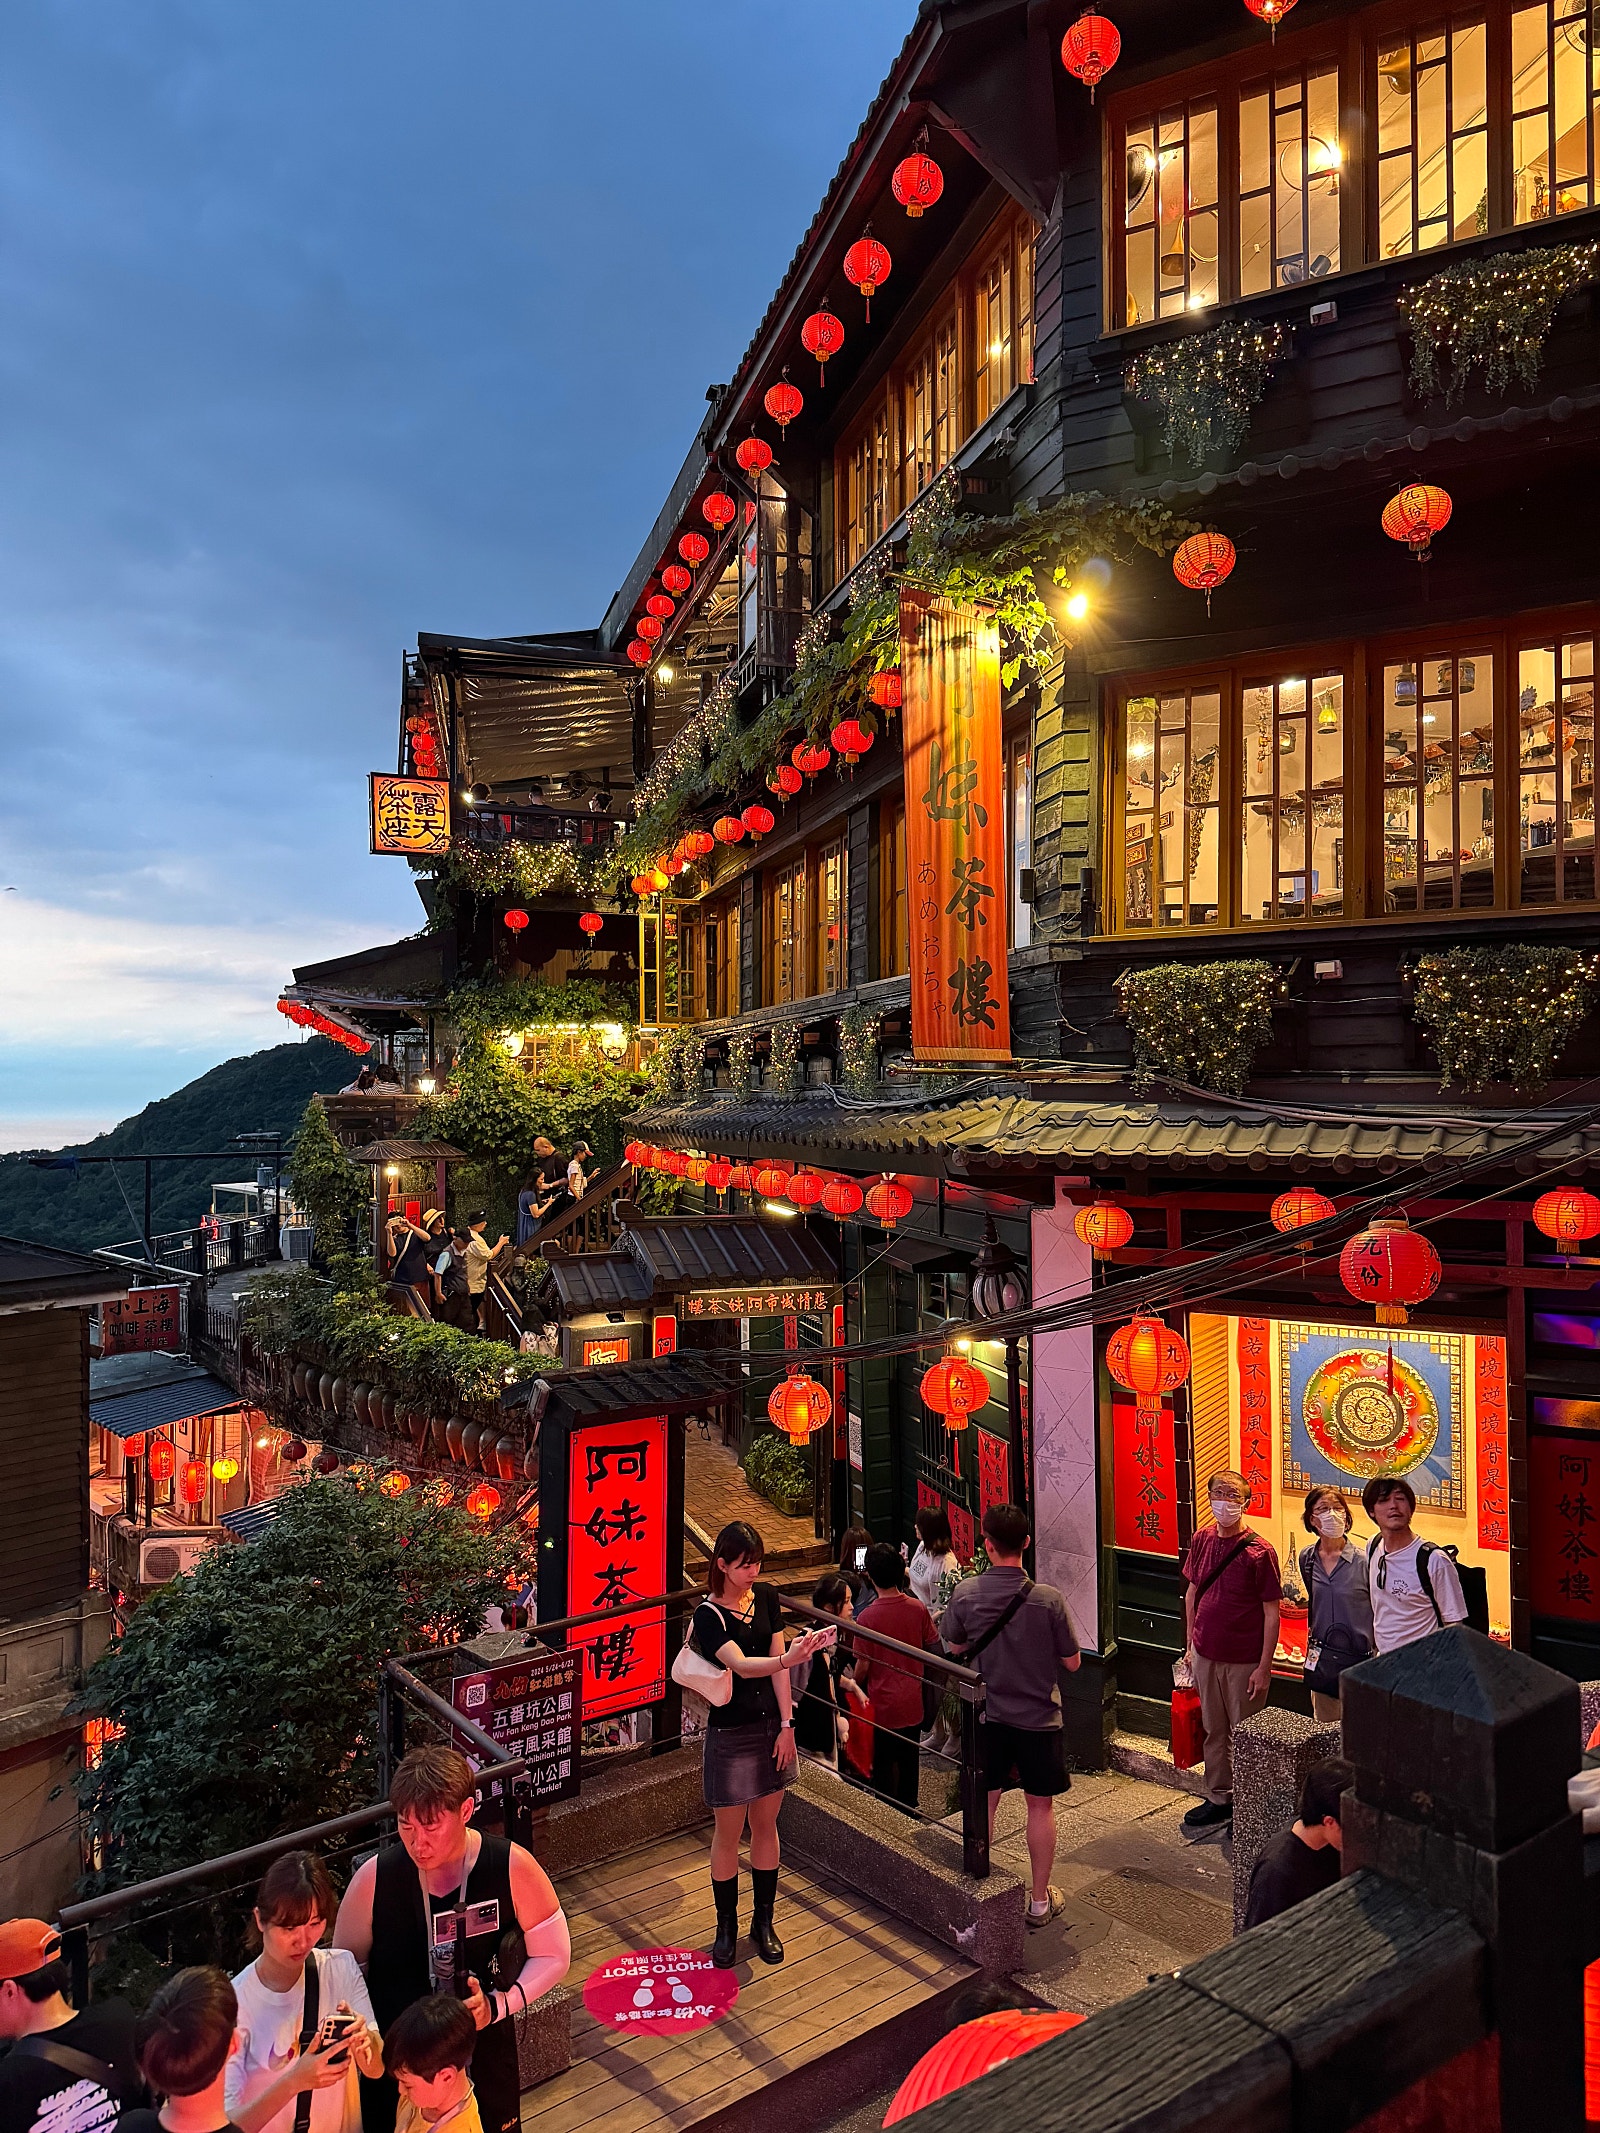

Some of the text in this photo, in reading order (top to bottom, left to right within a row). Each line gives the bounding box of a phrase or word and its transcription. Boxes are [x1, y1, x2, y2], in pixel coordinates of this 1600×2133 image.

[918, 160, 936, 195] 九份
[870, 241, 884, 273] 九份
[821, 314, 835, 343] 九份
[1404, 490, 1422, 519] 九份
[918, 860, 947, 1020] あめおちゃ
[842, 1187, 853, 1212] 九份
[887, 1189, 900, 1218] 九份
[1088, 1213, 1100, 1244] 九份
[1564, 1198, 1580, 1236] 九份
[1360, 1238, 1384, 1288] 九份
[109, 1293, 173, 1315] 小上海
[1111, 1340, 1127, 1384] 九份
[1164, 1344, 1182, 1387] 九份
[952, 1376, 969, 1407] 九份
[1132, 1408, 1167, 1542] 阿妹茶樓
[1555, 1454, 1598, 1604] 阿妹茶樓
[585, 1440, 650, 1681] 阿妹茶樓
[531, 1666, 544, 1677] 2024
[492, 1692, 572, 1730] 五番坑公園
[492, 1711, 572, 1740] Wu Fan Keng Dao Park
[501, 1726, 571, 1758] 芳風采館
[524, 1744, 571, 1765] xhibition Hall
[536, 1781, 562, 1796] Parklet
[602, 1959, 715, 1978] PHOTO SPOT
[621, 1952, 693, 1965] 最佳拍照點
